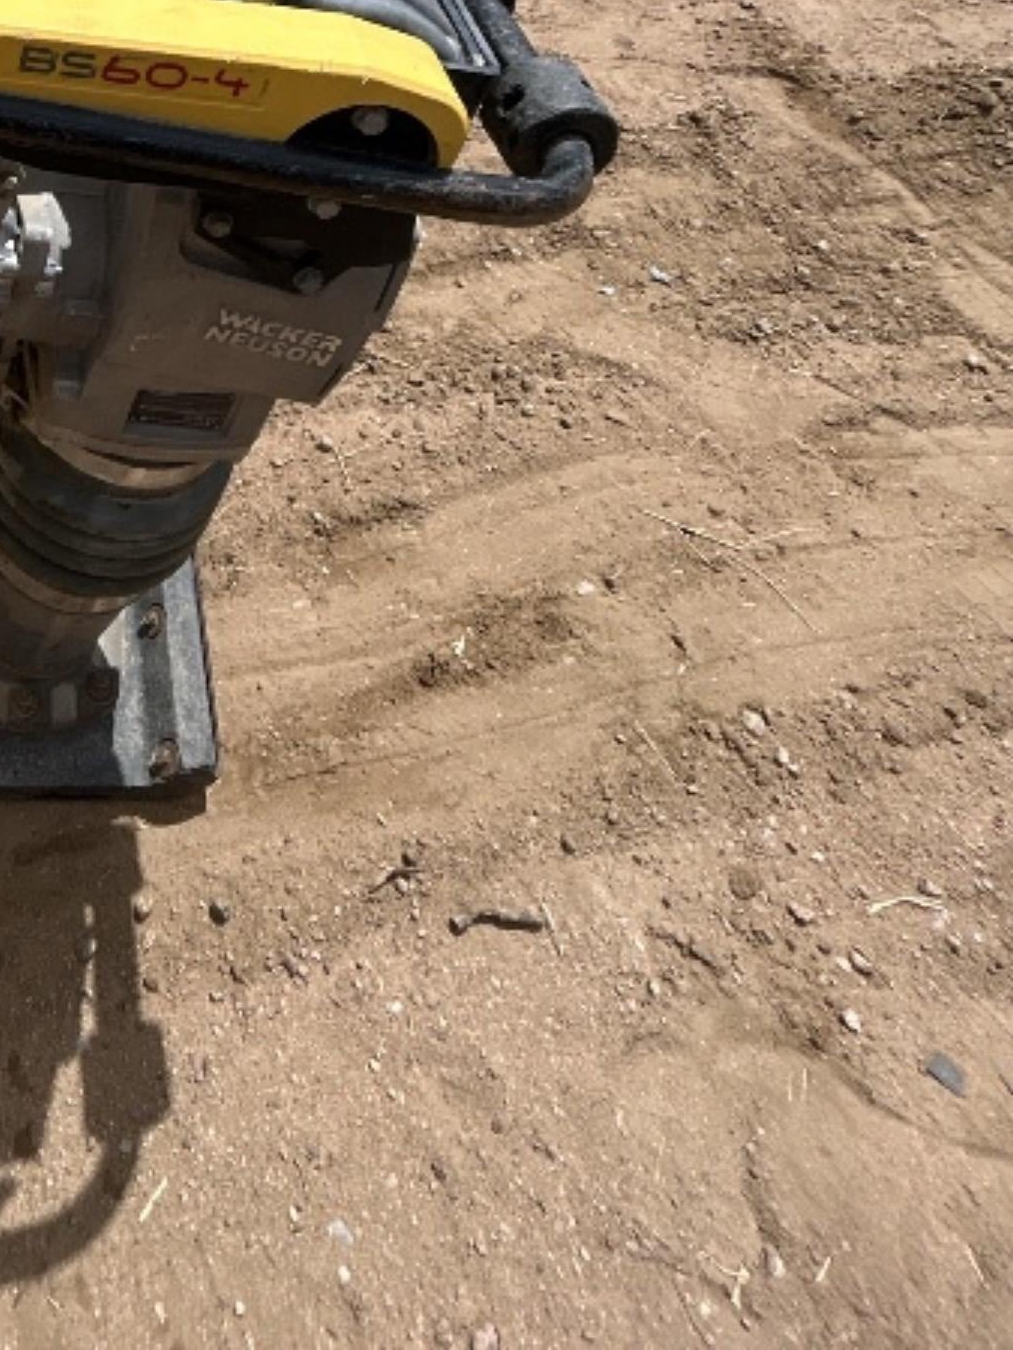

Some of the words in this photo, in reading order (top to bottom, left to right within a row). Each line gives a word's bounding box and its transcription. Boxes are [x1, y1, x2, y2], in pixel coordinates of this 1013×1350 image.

[19, 45, 250, 97] BS60-4
[203, 325, 334, 368] NEUSON
[219, 307, 342, 353] WACKER
